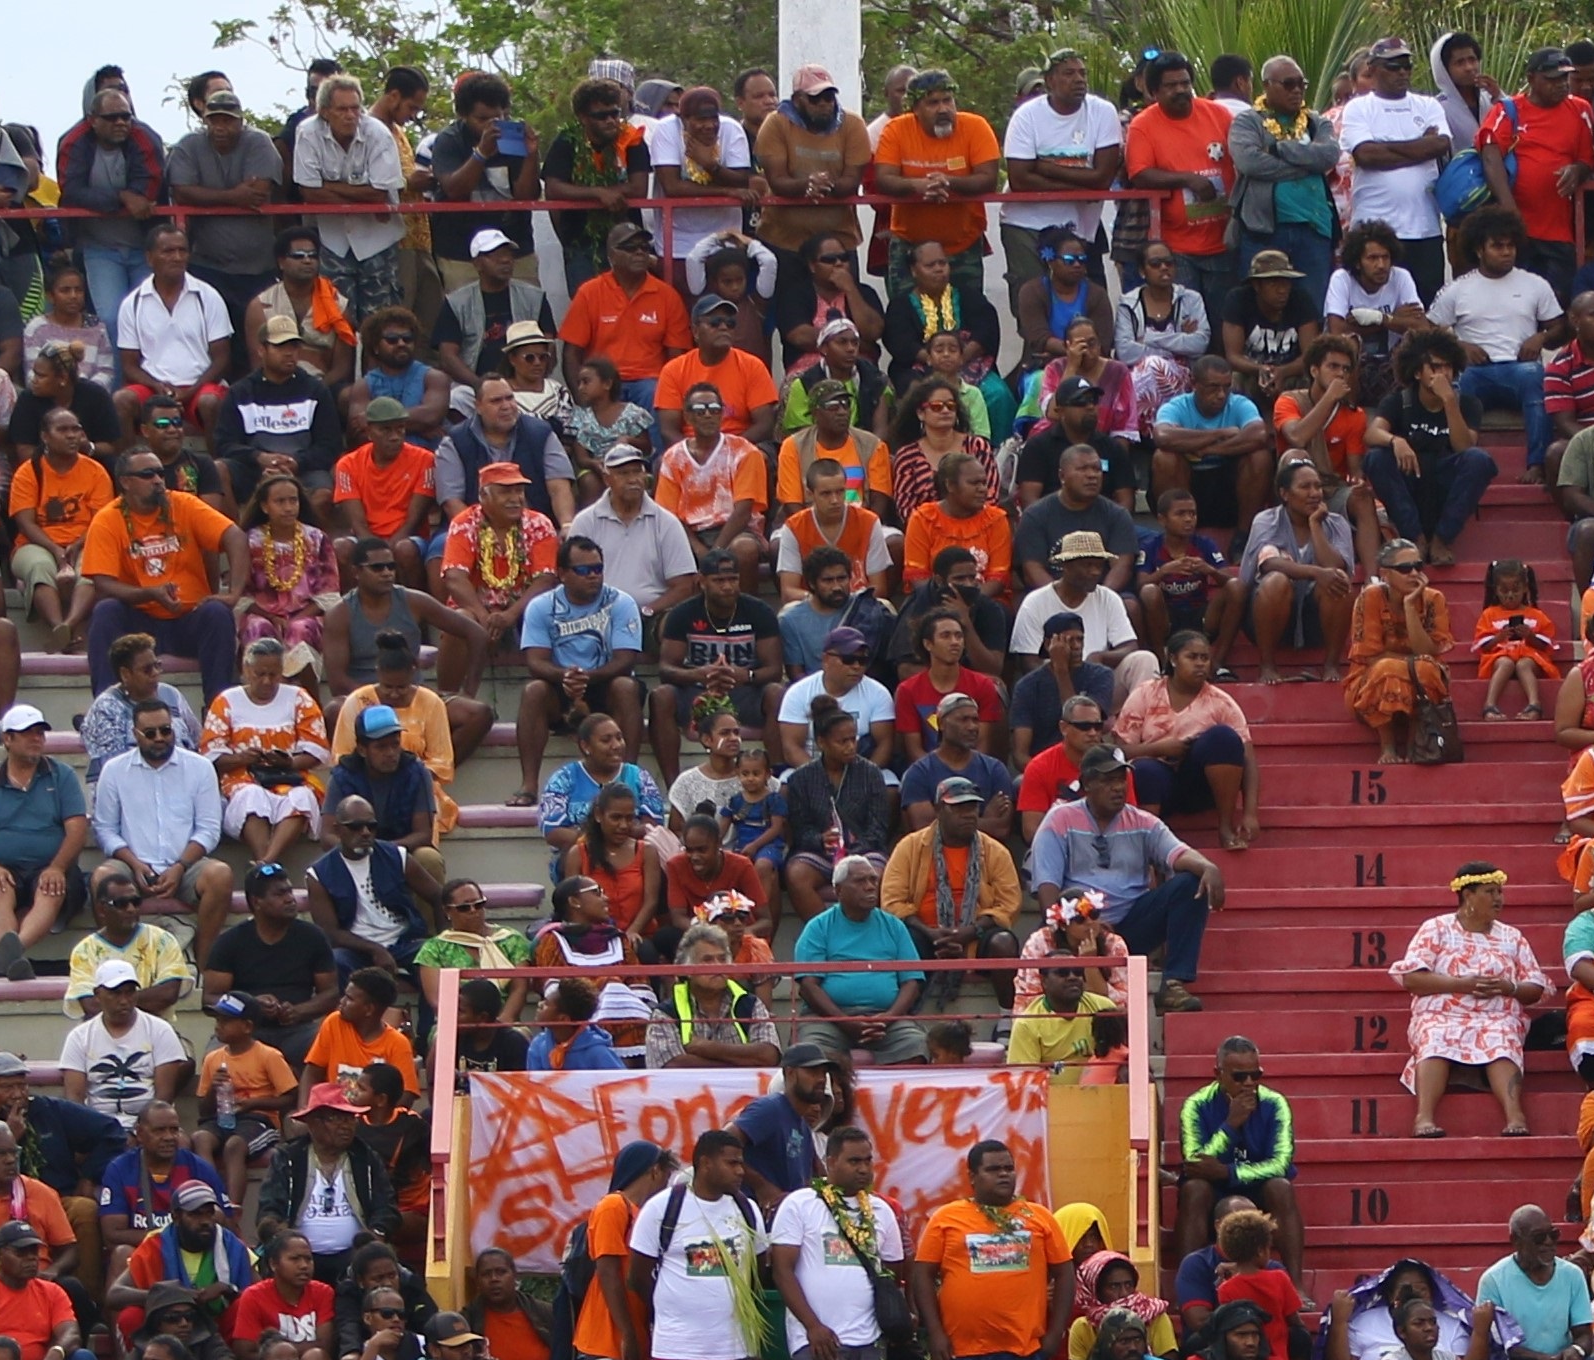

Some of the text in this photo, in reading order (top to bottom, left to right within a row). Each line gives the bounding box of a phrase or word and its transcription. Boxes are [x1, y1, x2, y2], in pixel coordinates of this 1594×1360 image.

[253, 413, 309, 430] ellesse
[1351, 769, 1387, 804] 15
[1354, 852, 1386, 888] 14
[1352, 931, 1388, 967] 13
[1353, 1014, 1389, 1051] 12
[1351, 1097, 1380, 1135] 11
[1350, 1188, 1390, 1226] 10
